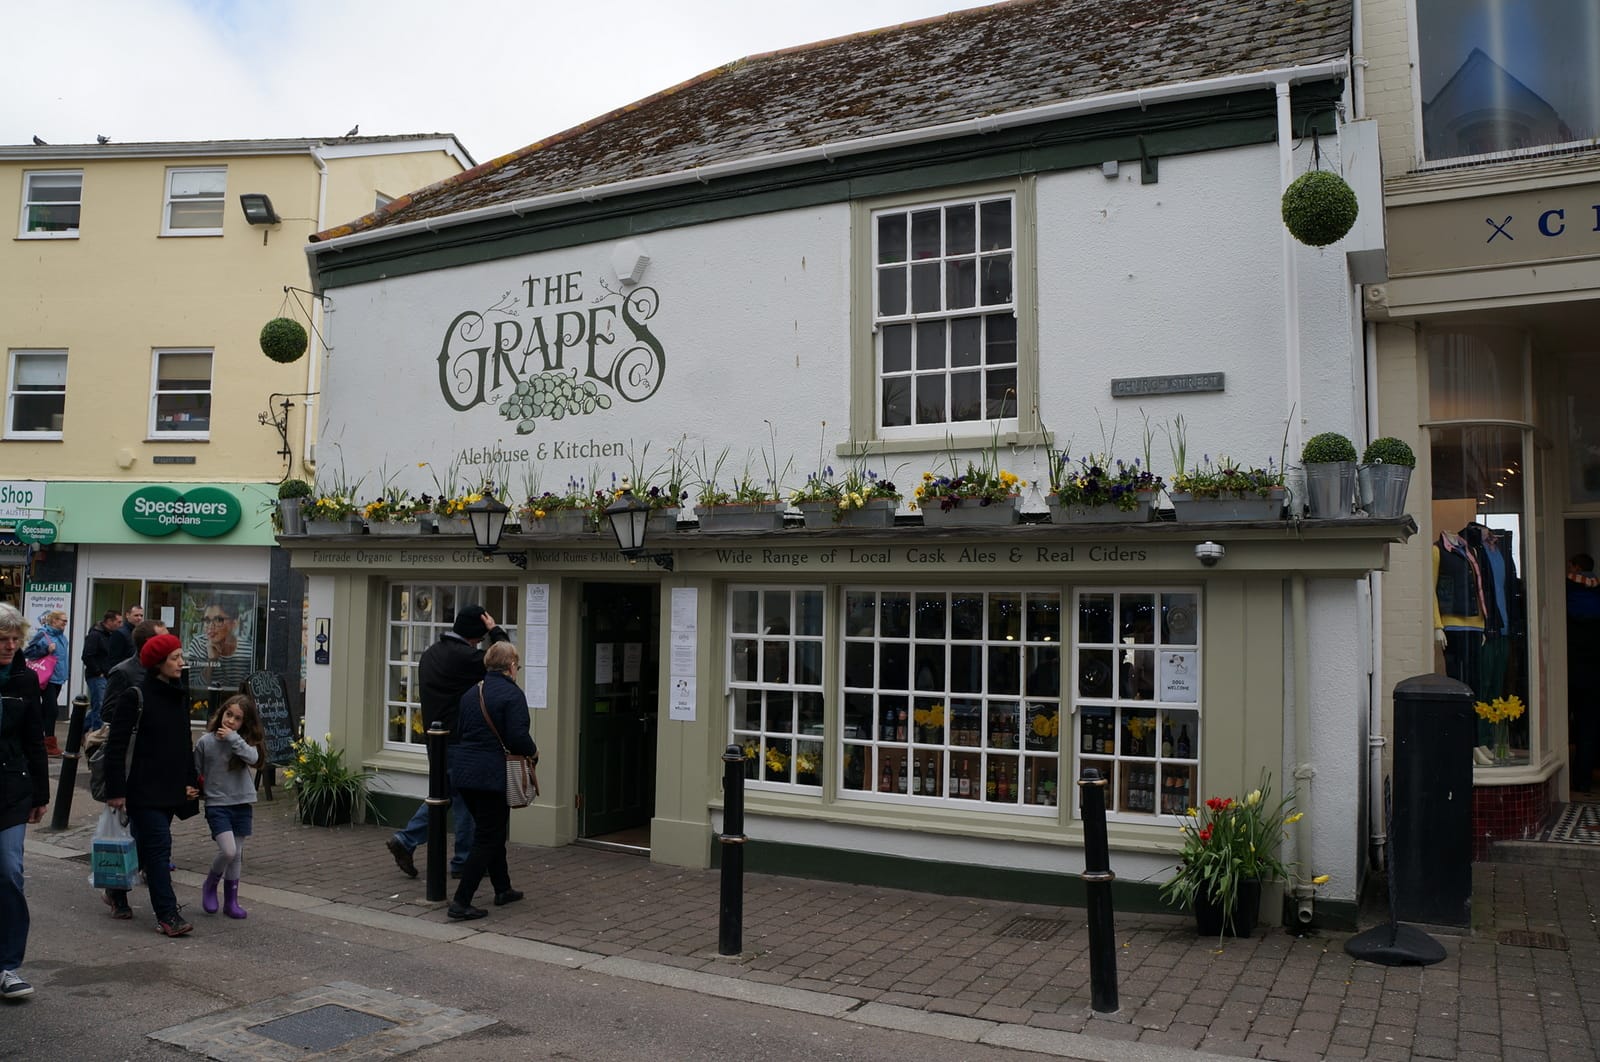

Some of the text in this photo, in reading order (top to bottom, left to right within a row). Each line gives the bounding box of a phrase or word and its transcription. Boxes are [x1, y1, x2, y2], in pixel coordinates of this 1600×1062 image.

[522, 271, 583, 308] THE
[437, 286, 666, 412] GRAPES
[458, 439, 624, 466] Alehouse & Kitchen
[1, 485, 33, 507] Shop
[134, 497, 227, 516] Specsavers
[158, 515, 200, 525] Opticians
[22, 525, 54, 535] Specsavers
[312, 551, 351, 562] Fairtrade
[356, 551, 392, 564] Organic
[400, 550, 445, 565] Espresso
[535, 551, 560, 561] World
[563, 551, 587, 561] Rums
[600, 551, 620, 562] Malt
[716, 546, 1147, 566] Wide Range of Local Cask Ales & Real Ciders
